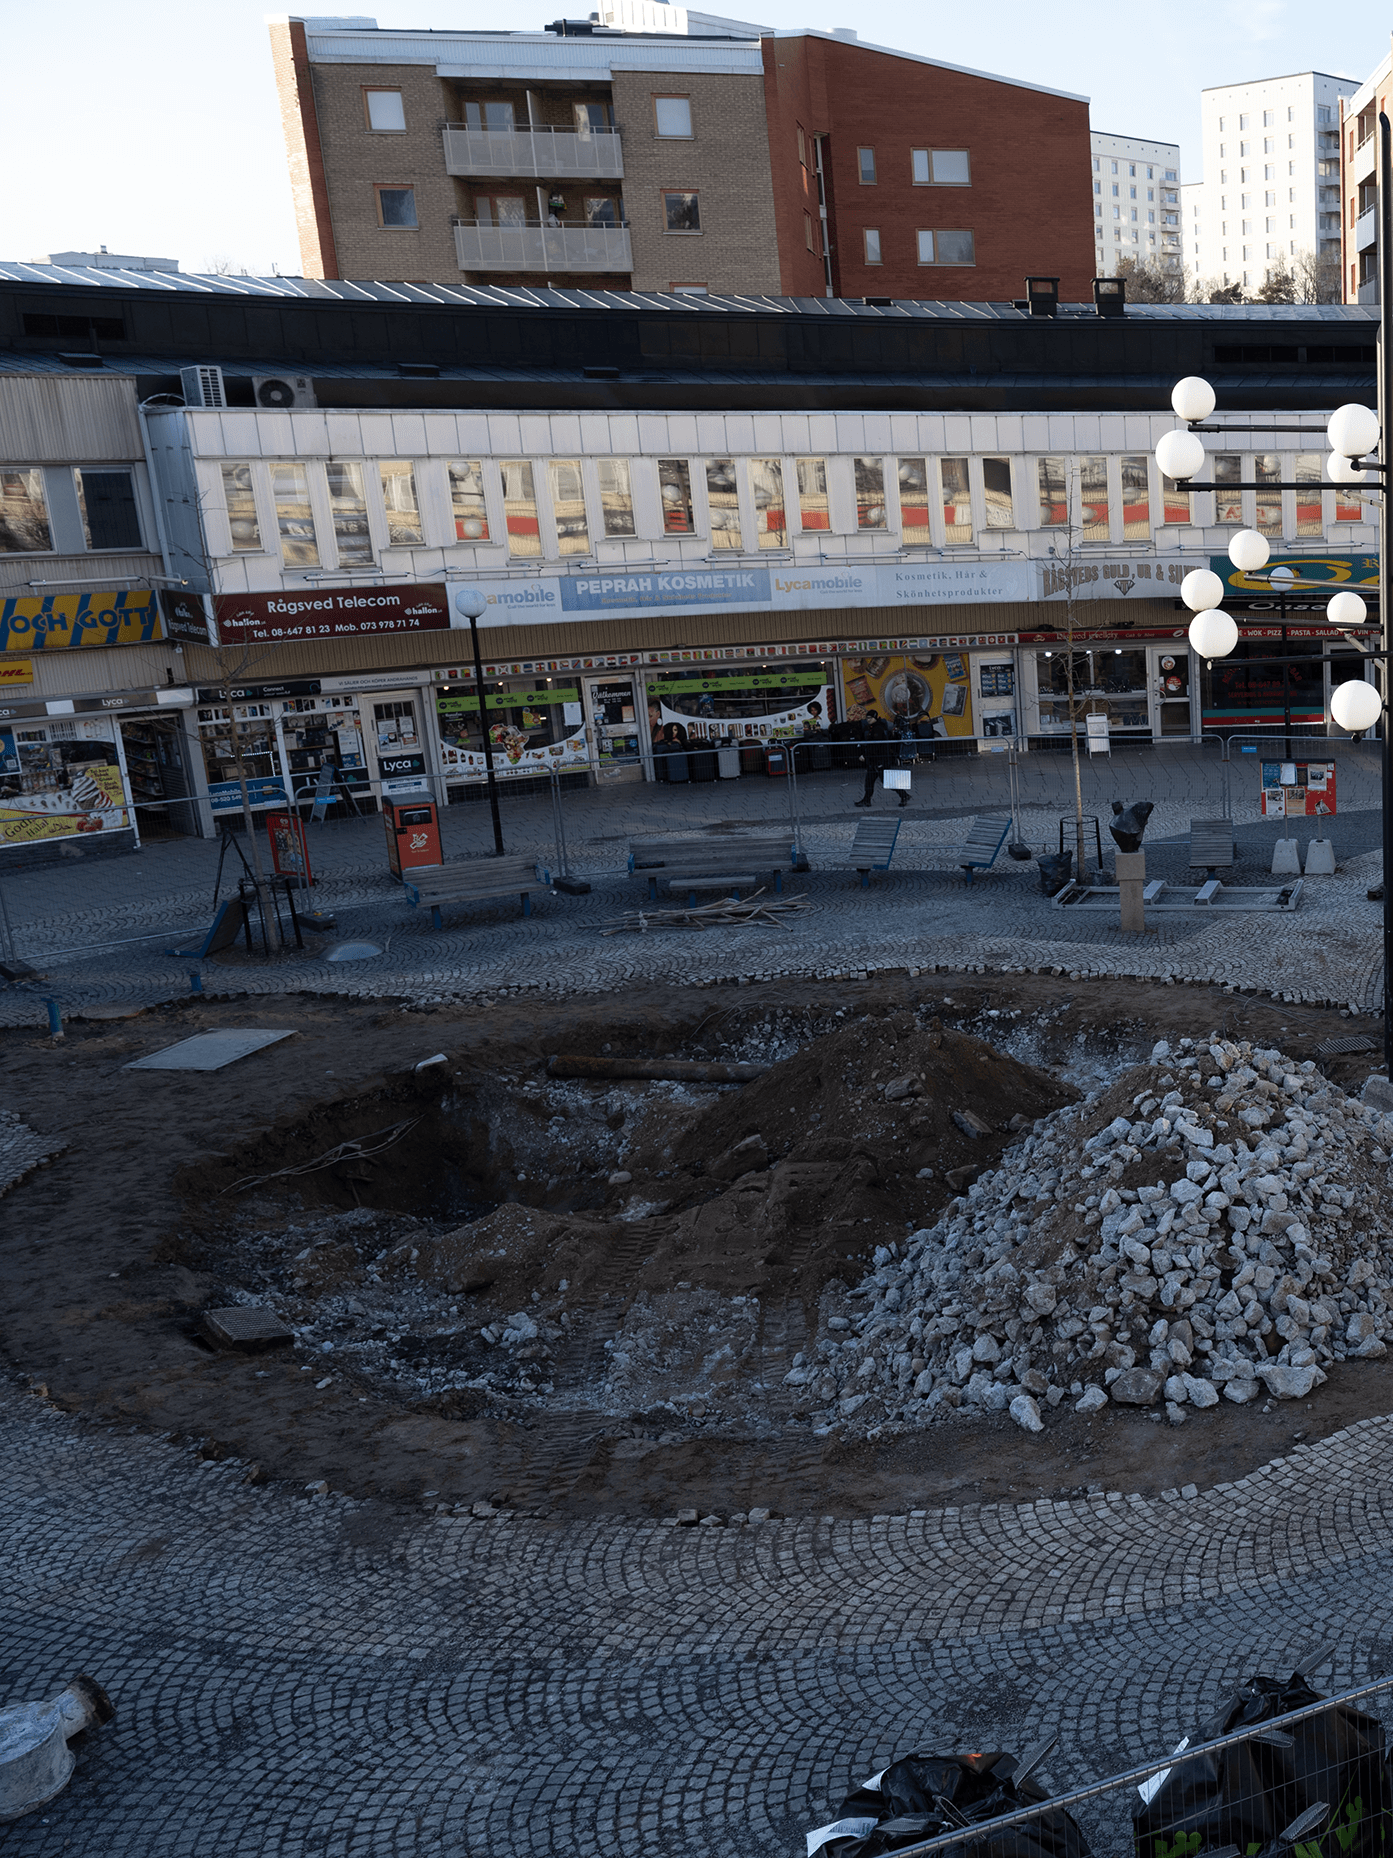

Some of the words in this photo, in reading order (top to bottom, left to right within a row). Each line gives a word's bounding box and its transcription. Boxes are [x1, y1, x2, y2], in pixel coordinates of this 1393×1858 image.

[895, 571, 952, 582] Kosmetik,
[978, 570, 988, 578] &
[1137, 563, 1152, 579] UR
[1155, 563, 1165, 581] &
[576, 577, 653, 595] PEPRAH
[657, 573, 755, 591] KOSMETIK
[775, 575, 863, 593] Lycamobile
[487, 588, 555, 605] amobile
[896, 586, 1003, 599] Skönhetsprodukter
[267, 597, 334, 615] Rågsved
[336, 594, 401, 609] Telecom
[8, 611, 69, 634] OCH
[77, 606, 152, 629] GOTT
[253, 629, 270, 639] Tel.
[271, 626, 304, 637] 08-647
[305, 626, 317, 636] 81
[318, 624, 330, 634] 23
[335, 623, 359, 634] Mob.
[360, 621, 377, 631] 073
[378, 619, 396, 629] 978
[396, 618, 407, 628] 71
[408, 618, 420, 628] 74
[1246, 629, 1263, 637] WOK
[1266, 629, 1283, 637] PIZZ
[1290, 629, 1311, 637] PASTA
[1357, 628, 1369, 636] VIN
[345, 678, 360, 686] SÄLJER
[360, 677, 372, 685] OCH
[371, 676, 386, 684] KÖPER
[218, 688, 245, 699] Lca
[263, 685, 285, 694] Connect
[102, 697, 124, 707] Lyca
[383, 758, 412, 772] Lyca
